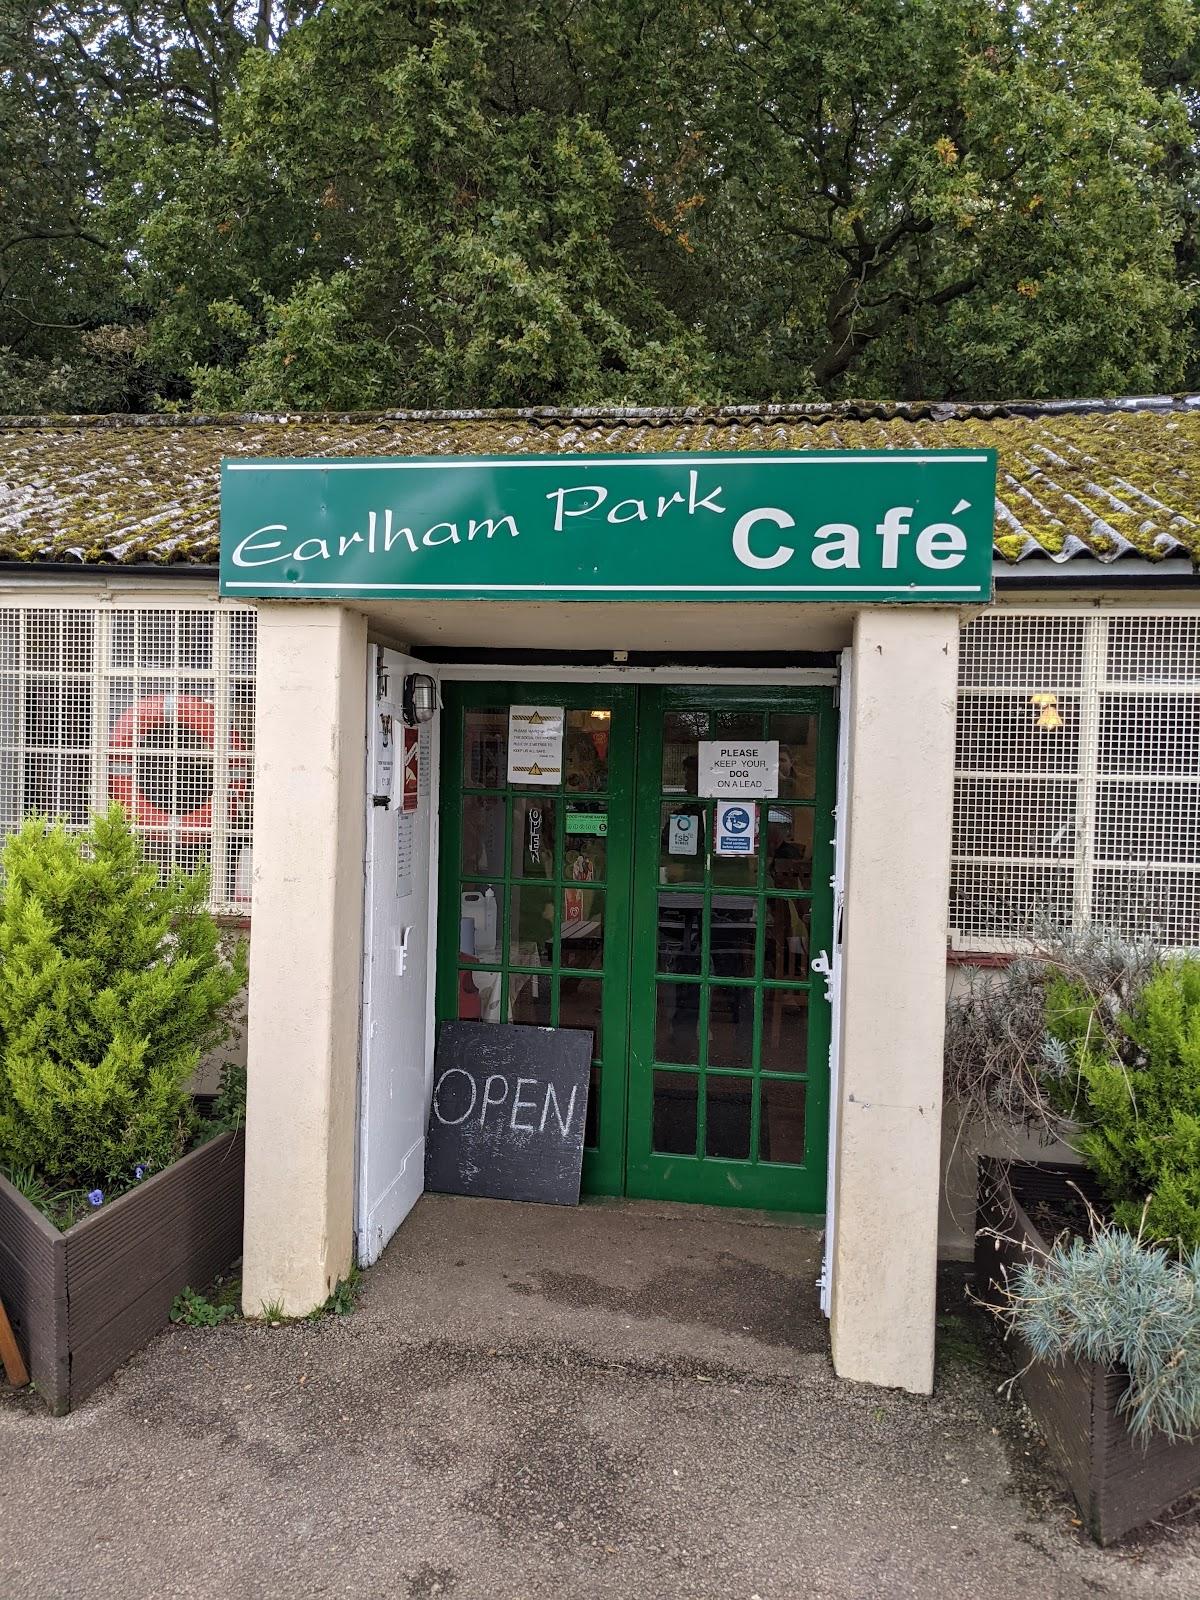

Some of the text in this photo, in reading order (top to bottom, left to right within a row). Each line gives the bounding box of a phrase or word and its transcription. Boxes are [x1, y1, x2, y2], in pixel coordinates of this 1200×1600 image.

[232, 470, 967, 570] Earlham Park Café
[720, 749, 758, 757] PLEASE
[529, 808, 542, 864] OPEN
[674, 832, 689, 842] fsb
[433, 1068, 578, 1137] OPEN
